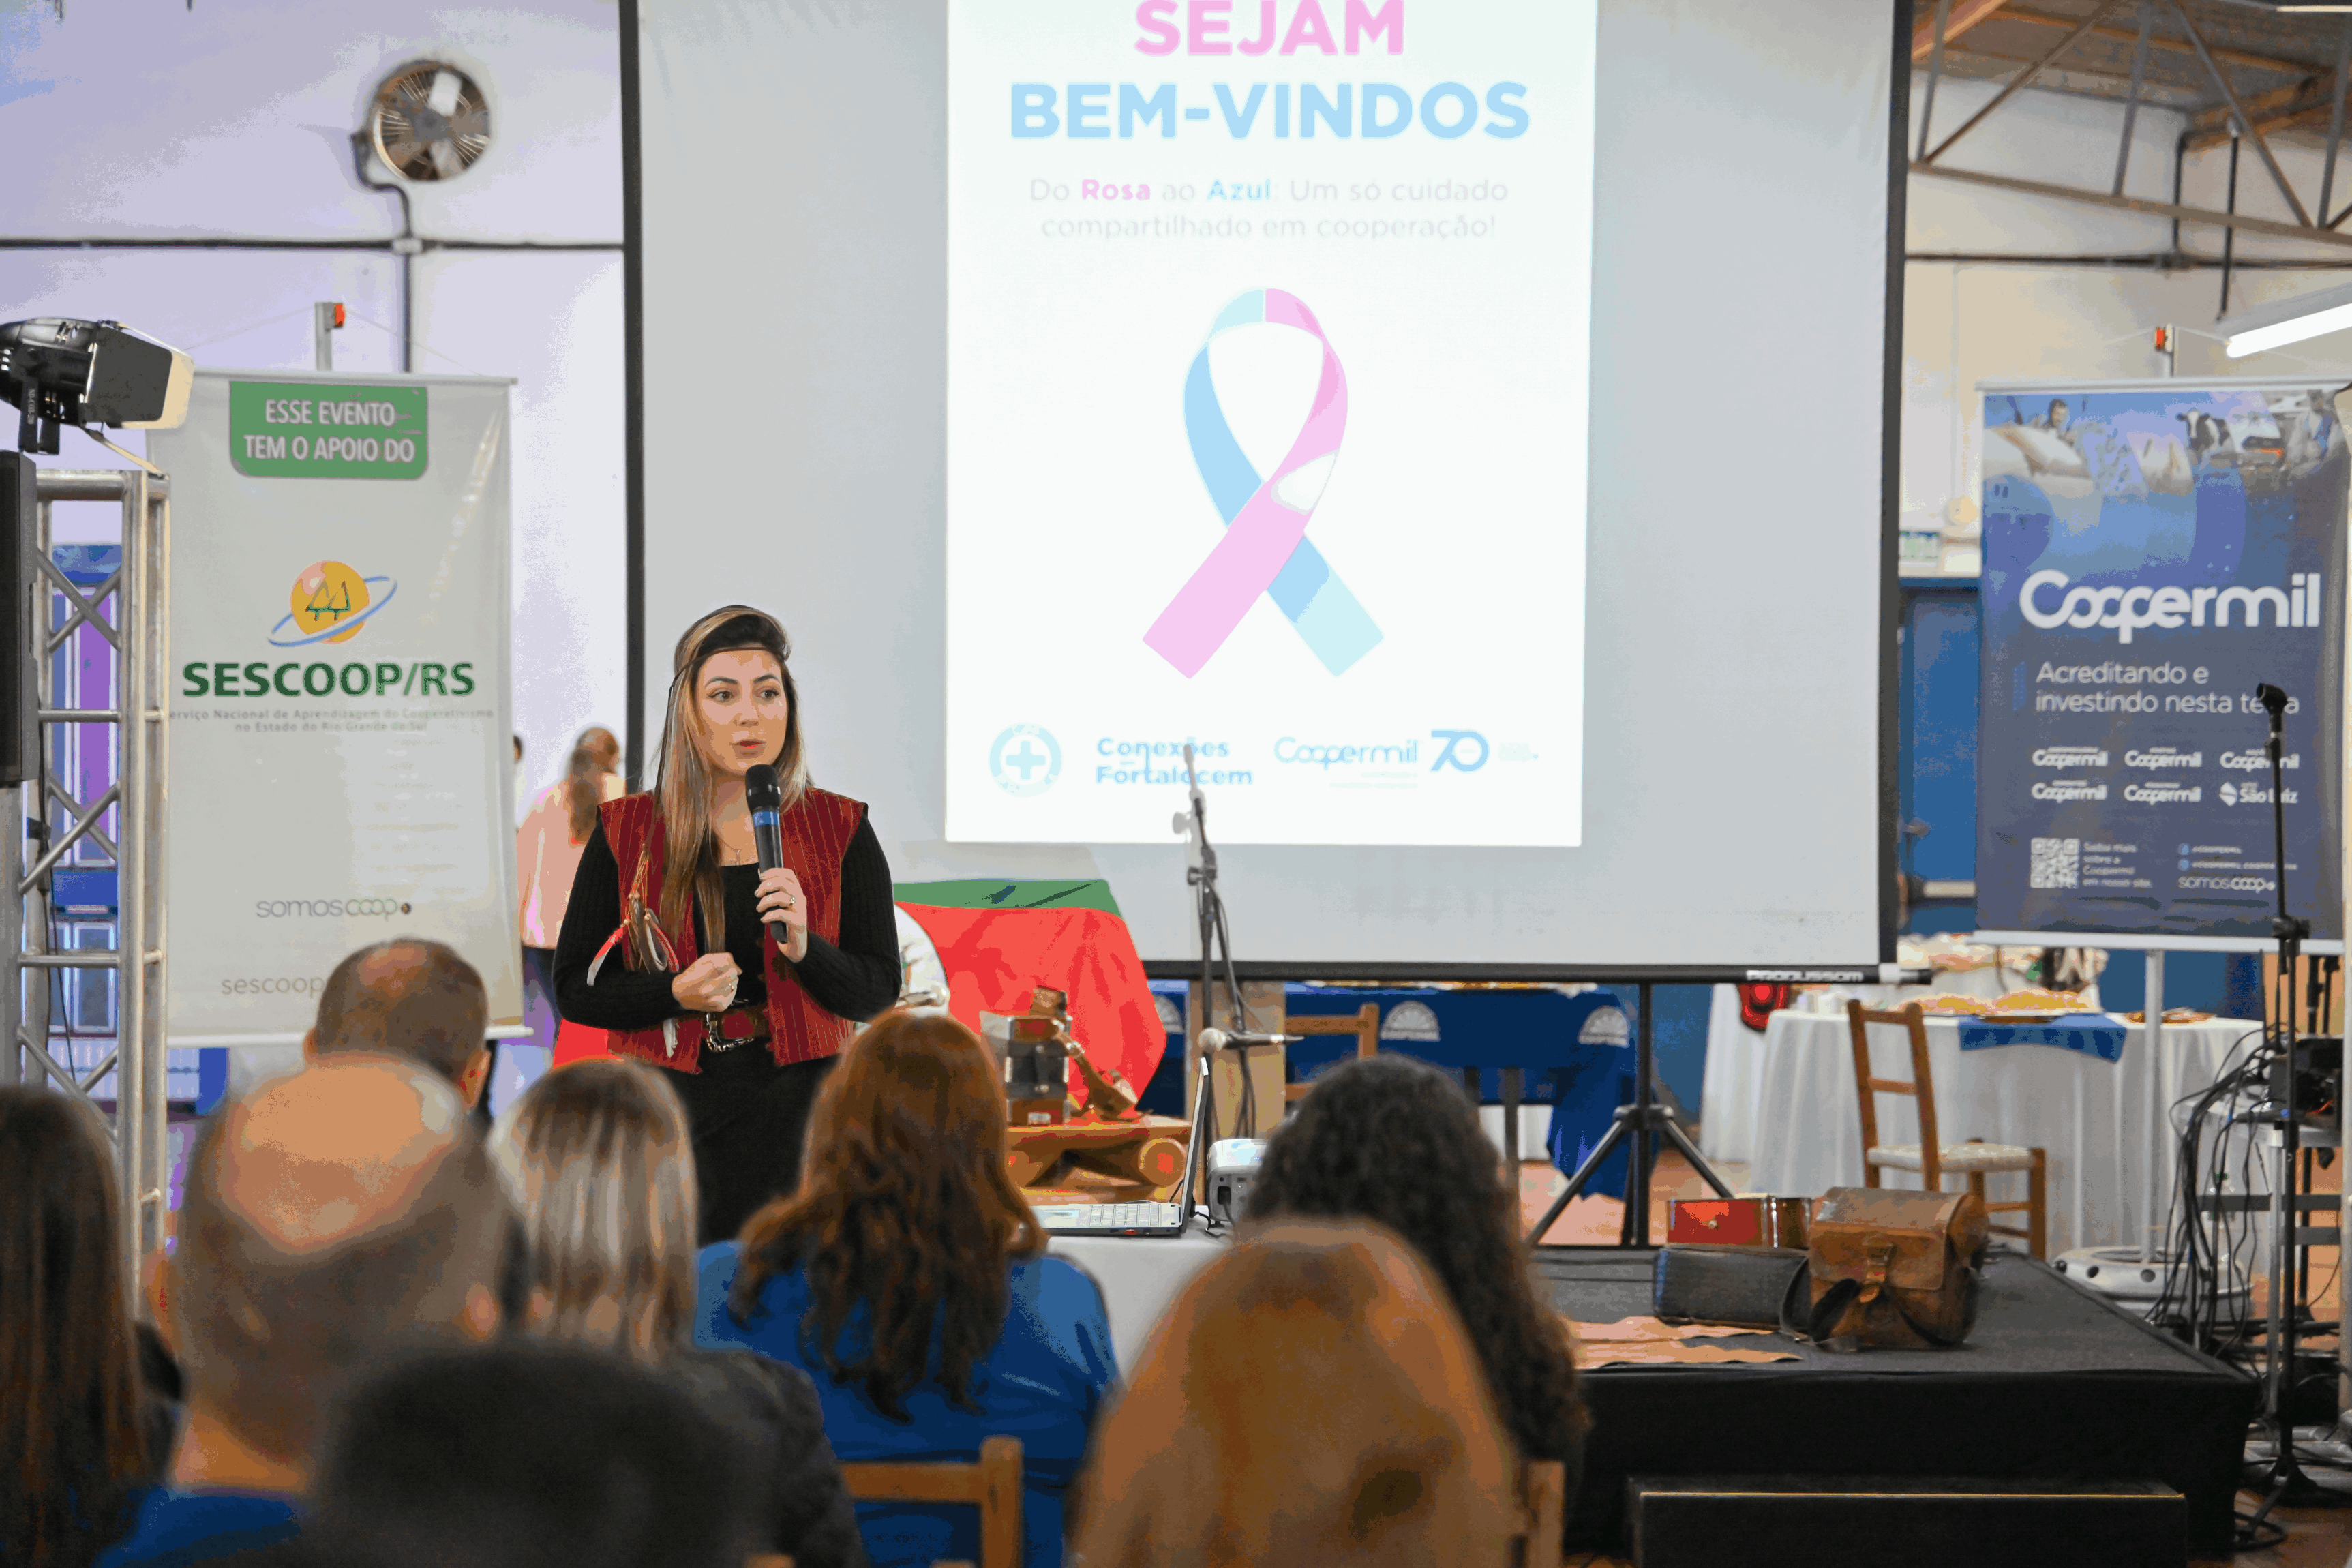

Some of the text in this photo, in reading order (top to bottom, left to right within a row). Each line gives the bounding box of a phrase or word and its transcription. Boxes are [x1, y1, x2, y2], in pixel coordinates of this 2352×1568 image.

[1134, 0, 1404, 56] SEJAM
[1012, 81, 1530, 139] BEM-VINDOS
[1031, 177, 1070, 202] Do
[1081, 179, 1151, 200] Rosa
[1162, 182, 1196, 202] ao
[1289, 179, 1338, 202] Um
[1349, 177, 1381, 202] só
[1391, 177, 1509, 202] cuidado
[1041, 213, 1496, 241] compartilhado em cooperação!
[265, 399, 397, 427] ESSE EVENTO
[243, 434, 416, 463] TEM O APOIO DO
[2019, 569, 2321, 644] Coopermil
[183, 662, 475, 697] SESCOOP/RS
[2036, 661, 2210, 685] Acreditando e
[169, 709, 209, 721] erviço
[213, 709, 269, 720] Nacional
[2036, 690, 2300, 714] investindo nesta tea
[1273, 736, 1419, 771] Coopermil
